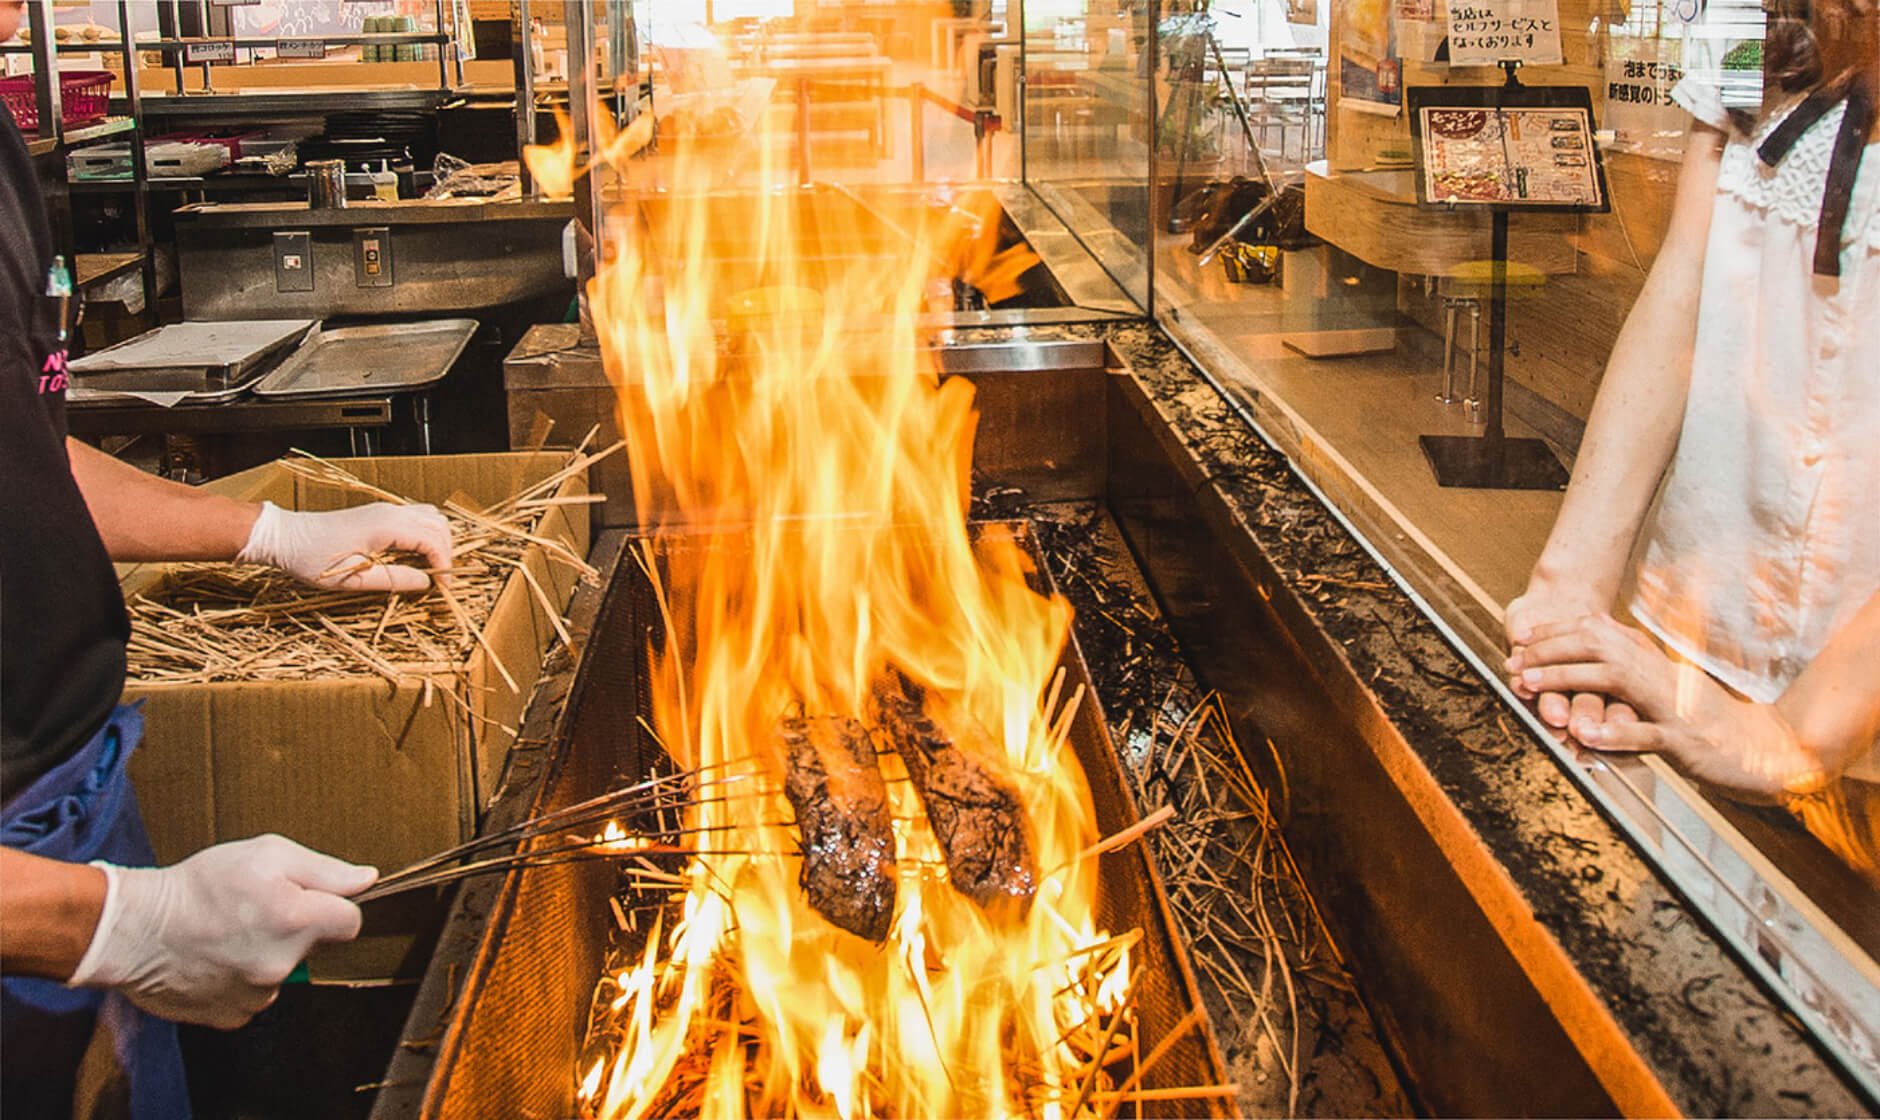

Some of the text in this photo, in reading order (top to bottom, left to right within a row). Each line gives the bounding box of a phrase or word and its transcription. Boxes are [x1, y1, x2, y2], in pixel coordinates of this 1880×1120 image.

[1451, 7, 1493, 20] 当店は
[1453, 18, 1552, 32] セルフサービスと
[1453, 34, 1534, 48] なっております
[1608, 82, 1681, 108] 新感覚のドラ
